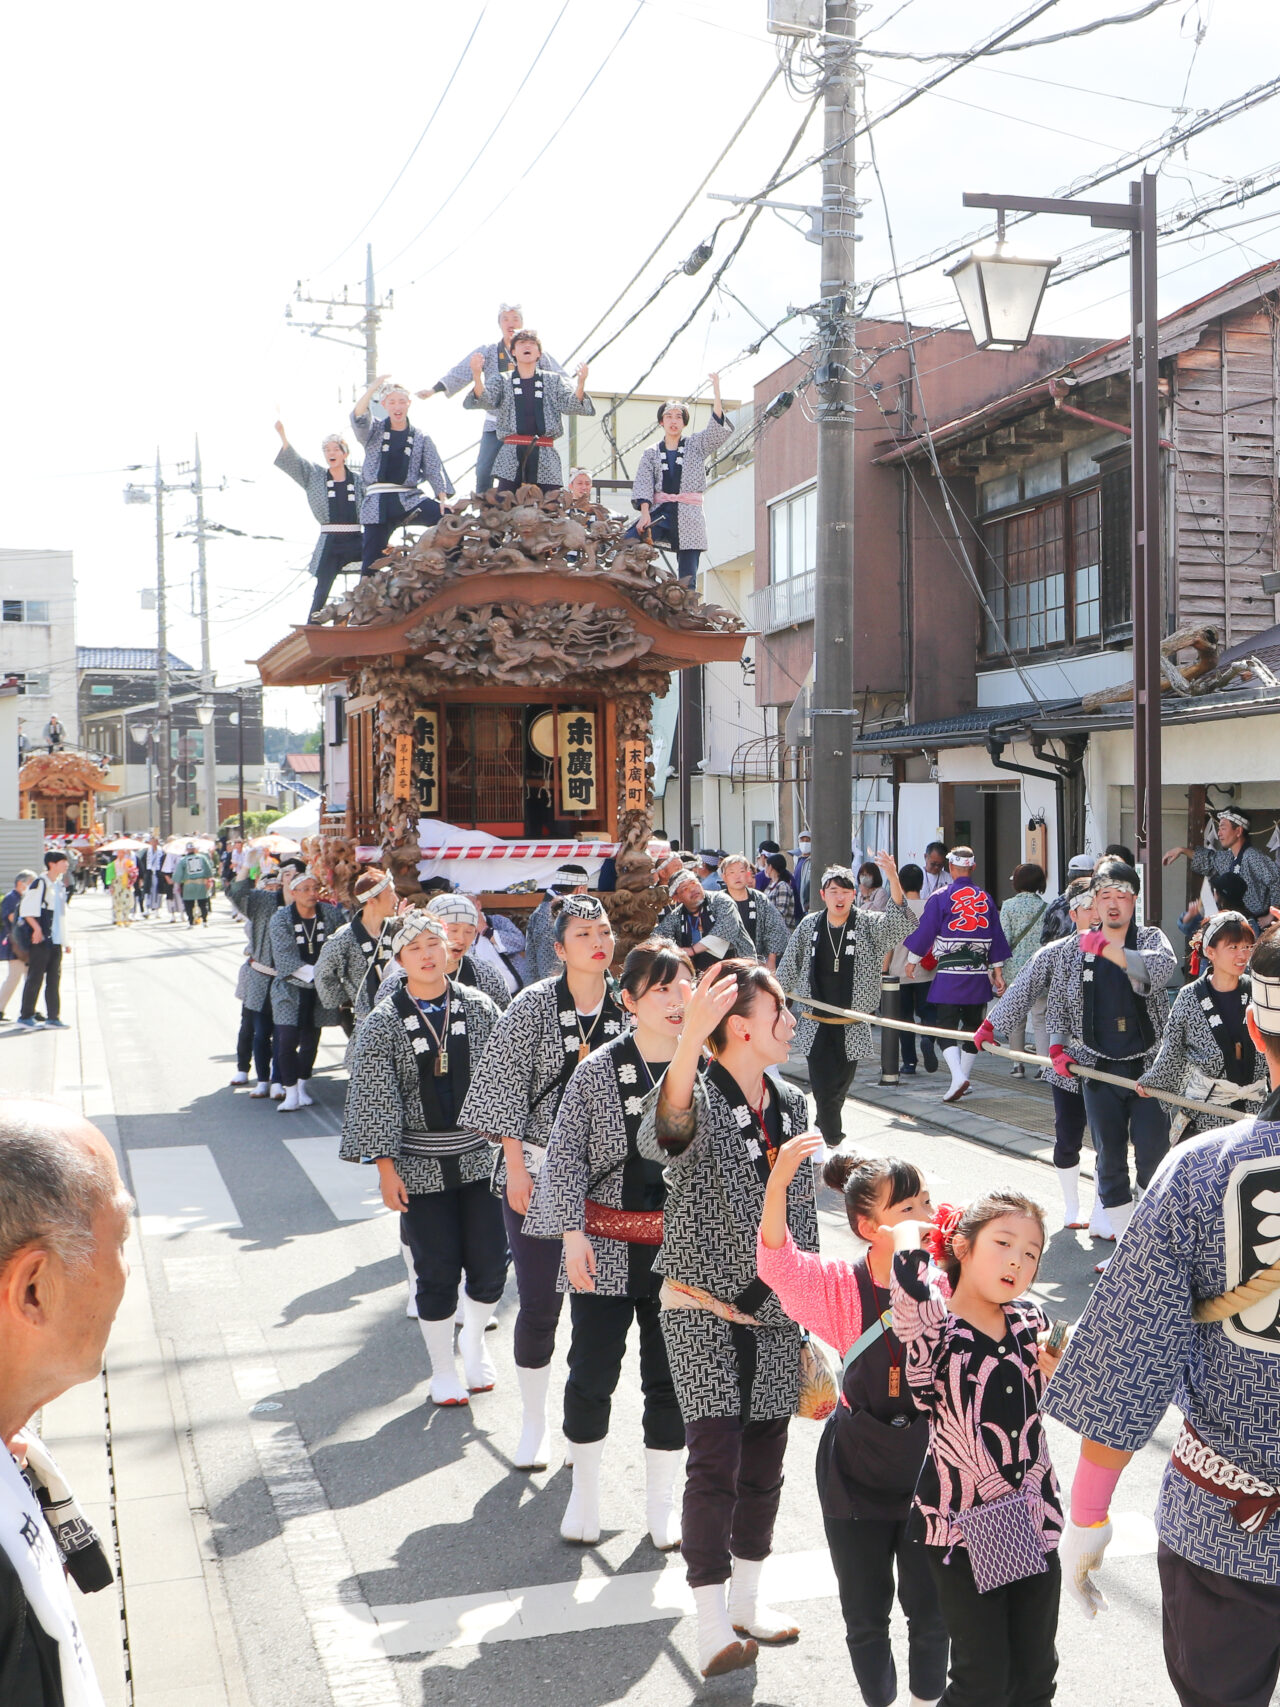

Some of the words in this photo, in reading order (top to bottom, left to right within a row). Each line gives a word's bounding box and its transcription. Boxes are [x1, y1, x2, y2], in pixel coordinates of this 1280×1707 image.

[567, 716, 594, 806] 末廣町
[628, 748, 644, 803] 末廣町
